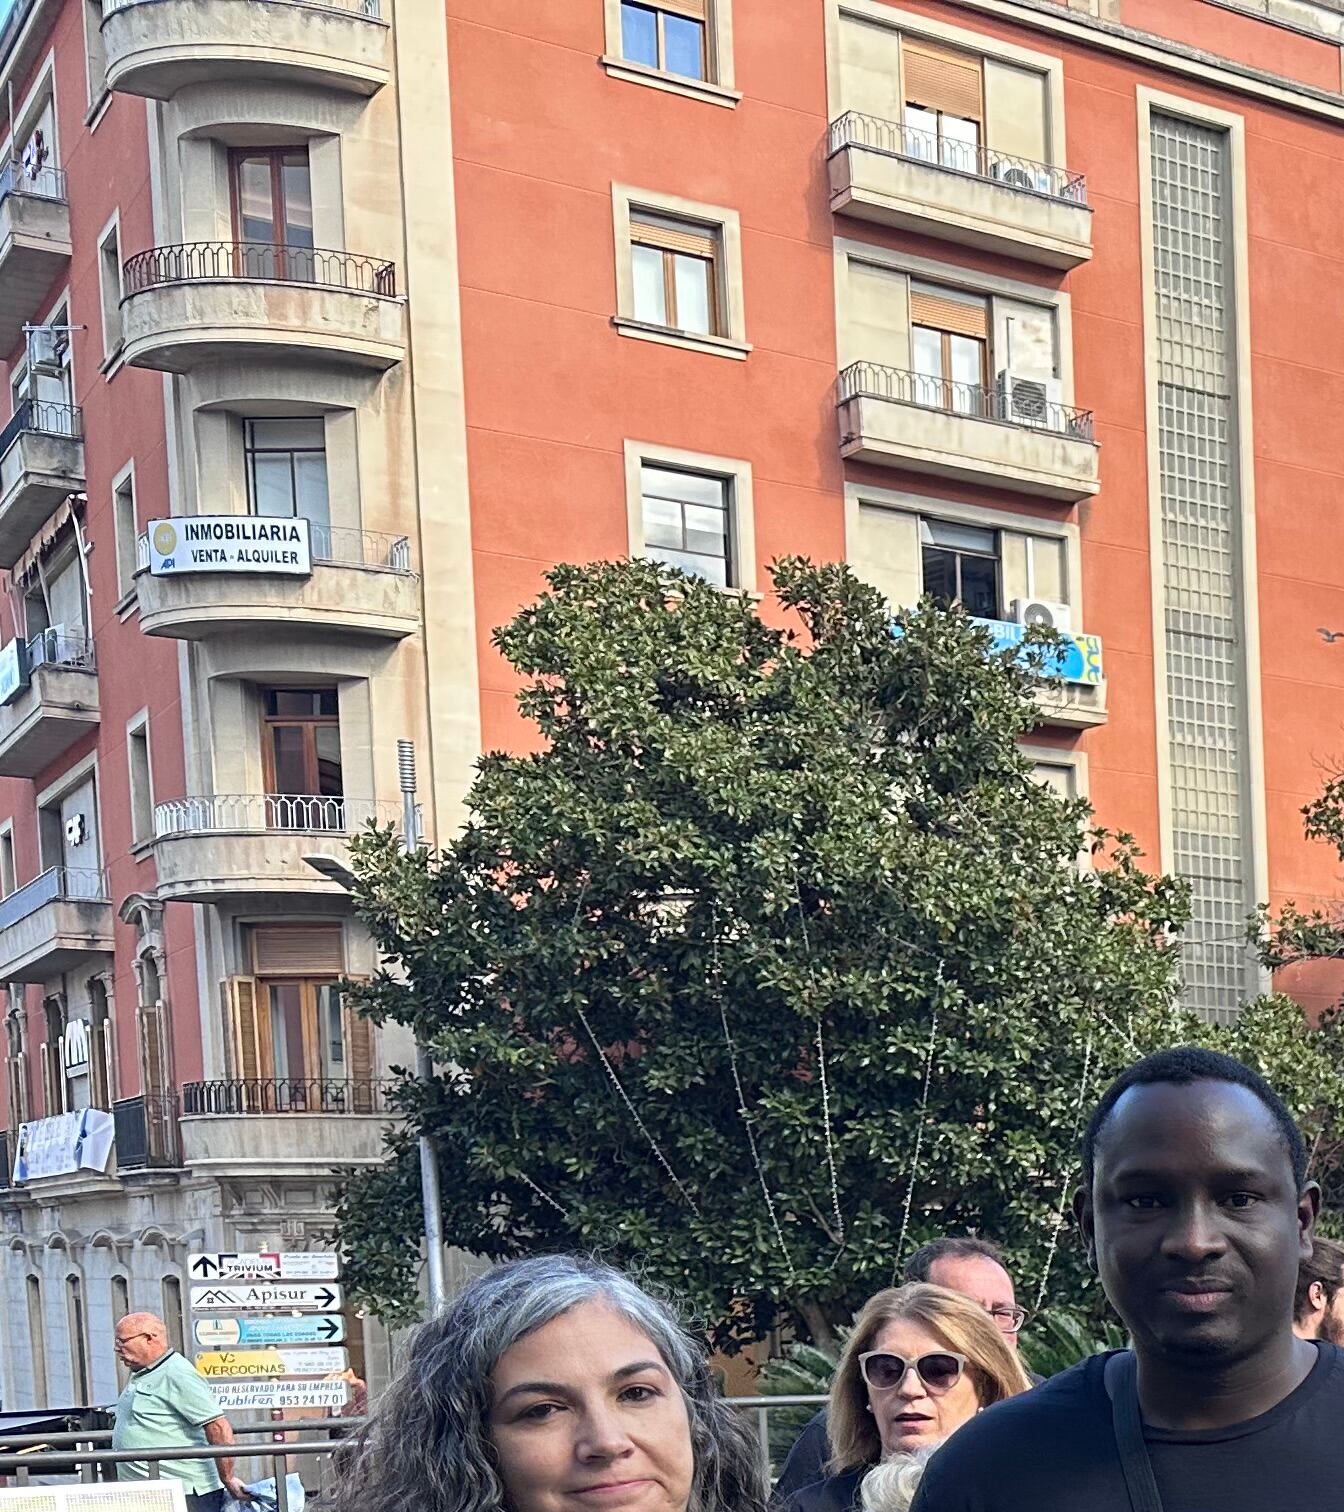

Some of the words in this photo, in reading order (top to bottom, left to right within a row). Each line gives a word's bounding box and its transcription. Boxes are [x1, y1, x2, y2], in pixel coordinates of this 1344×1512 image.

[185, 523, 301, 542] INMOBILIARIA
[191, 549, 228, 563] VENTA
[237, 549, 299, 564] ALQUILER
[246, 1287, 307, 1304] Apisur
[203, 1364, 286, 1376] VERCOCINAS
[231, 1384, 275, 1394] RESERVADO
[276, 1384, 296, 1393] PARA
[297, 1384, 307, 1392] SU
[308, 1382, 343, 1391] EMPRESA
[279, 1395, 299, 1406] 953
[302, 1395, 316, 1405] 24
[318, 1394, 330, 1404] 17
[332, 1394, 344, 1404] 01
